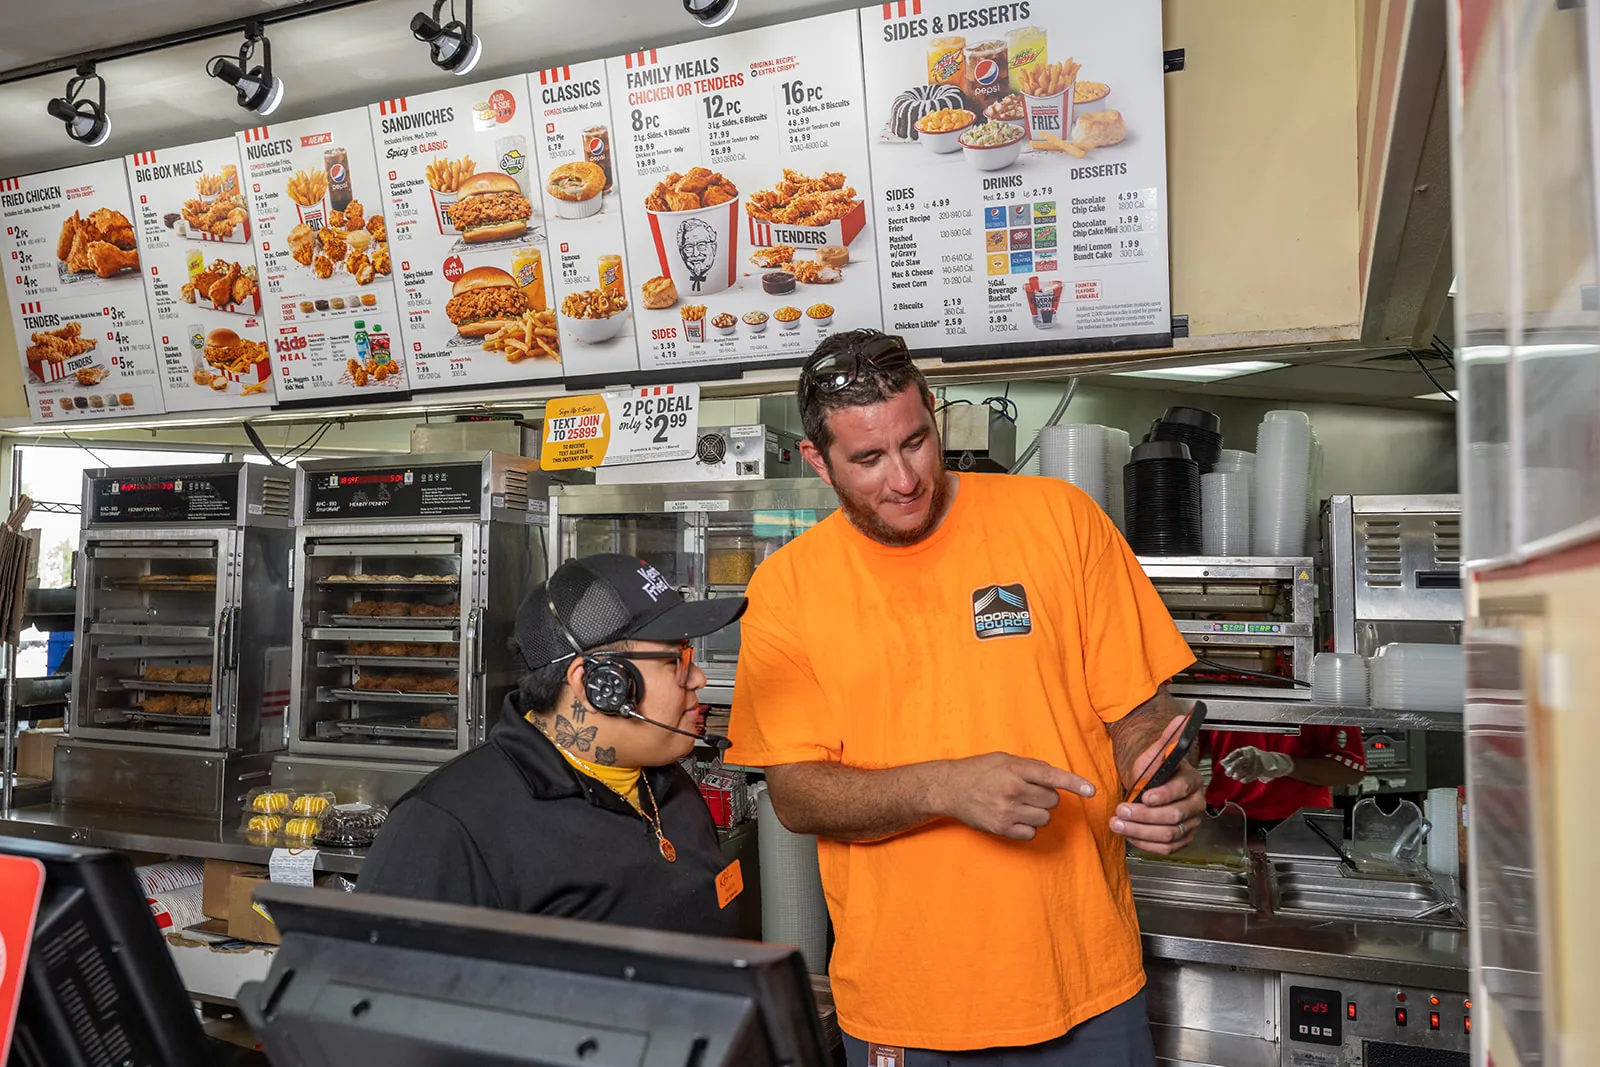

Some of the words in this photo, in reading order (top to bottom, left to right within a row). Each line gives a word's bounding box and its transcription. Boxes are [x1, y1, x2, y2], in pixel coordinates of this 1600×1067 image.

[883, 18, 928, 43] SIDES
[932, 16, 944, 34] &
[948, 1, 1031, 32] DESSERTS
[750, 59, 774, 69] ORIGINAL
[627, 66, 672, 89] FAMILY
[675, 57, 720, 80] MEALS
[758, 67, 776, 76] EXTRA
[542, 80, 601, 104] CLASSICS
[628, 85, 675, 106] CHICKEN
[676, 82, 692, 97] OR
[694, 73, 745, 94] TENDERS
[781, 80, 805, 106] 16
[806, 86, 823, 102] PC
[974, 85, 1001, 97] pepsi
[703, 94, 725, 119] 12
[726, 100, 742, 116] PC
[802, 105, 820, 114] Sides,
[826, 99, 850, 110] Biscuits
[381, 107, 455, 134] SANDWICHES
[631, 109, 643, 132] 8
[645, 115, 660, 130] PC
[788, 117, 810, 127] 48.99
[1031, 115, 1060, 130] FRIES
[647, 131, 663, 140] Sides,
[668, 126, 690, 137] Biscuits
[708, 130, 730, 141] 37.99
[789, 133, 811, 144] 34.99
[246, 139, 293, 160] NUGGETS
[386, 147, 409, 160] Spicy
[419, 140, 448, 153] CLASSIC
[634, 142, 655, 153] 29.99
[710, 146, 732, 157] 26.99
[636, 158, 656, 168] 19.99
[136, 168, 152, 183] BIG
[153, 165, 172, 180] BOX
[173, 160, 204, 177] MEALS
[1070, 162, 1128, 181] DESSERTS
[390, 181, 406, 190] Classic
[406, 178, 424, 187] Chicken
[983, 175, 1023, 190] DRINKS
[1, 192, 25, 208] FRIED
[25, 186, 61, 203] CHICKEN
[391, 188, 413, 197] Sandwich
[886, 188, 915, 201] SIDES
[996, 191, 1016, 200] 2.59
[1033, 187, 1053, 196] 2.79
[1118, 192, 1138, 201] 4.99
[1071, 195, 1106, 206] Chocolate
[1071, 206, 1087, 215] Chip
[1088, 205, 1106, 213] Cake
[888, 216, 909, 225] Secret
[909, 214, 931, 224] Recipe
[1072, 219, 1107, 229] Chocolate
[1119, 215, 1139, 224] 1.99
[888, 225, 904, 233] Fries
[1072, 229, 1087, 238] Chip
[1088, 227, 1104, 236] Cake
[1104, 226, 1118, 234] Mini
[774, 229, 827, 245] TENDERS
[889, 234, 913, 243] Mashed
[890, 242, 917, 250] Potatoes
[1073, 244, 1088, 252] Mini
[1089, 242, 1112, 251] Lemon
[1120, 240, 1140, 249] 1.99
[1073, 252, 1095, 261] Bundt
[1095, 250, 1113, 259] Cake
[891, 260, 904, 268] Cole
[905, 259, 921, 267] Slaw
[403, 271, 416, 280] Spicy
[416, 270, 433, 278] Chicken
[444, 267, 463, 277] SPICY
[891, 271, 905, 279] Mac
[911, 268, 934, 277] Cheese
[404, 278, 425, 287] Sandwich
[892, 282, 911, 290] Sweet
[912, 280, 927, 288] Corn
[988, 286, 1018, 295] Beverage
[944, 298, 962, 307] 2.19
[988, 294, 1011, 302] Bucket
[893, 303, 898, 311] 2
[898, 302, 924, 310] Biscuits
[23, 313, 60, 330] TENDERS
[945, 318, 963, 326] 2.59
[989, 315, 1008, 323] 3.99
[894, 321, 920, 330] Chicken
[651, 327, 677, 340] SIDES
[274, 336, 308, 353] kids
[280, 353, 307, 362] MEAL
[67, 356, 93, 371] TENDERS
[623, 401, 632, 417] 2
[635, 399, 654, 416] PC
[657, 395, 692, 413] DEAL
[553, 418, 576, 429] TEXT
[578, 415, 600, 427] JOIN
[619, 417, 642, 434] only
[554, 430, 565, 441] TO
[567, 427, 597, 440] 25899
[975, 611, 1029, 623] ROOFING
[976, 619, 1030, 631] SOURCE
